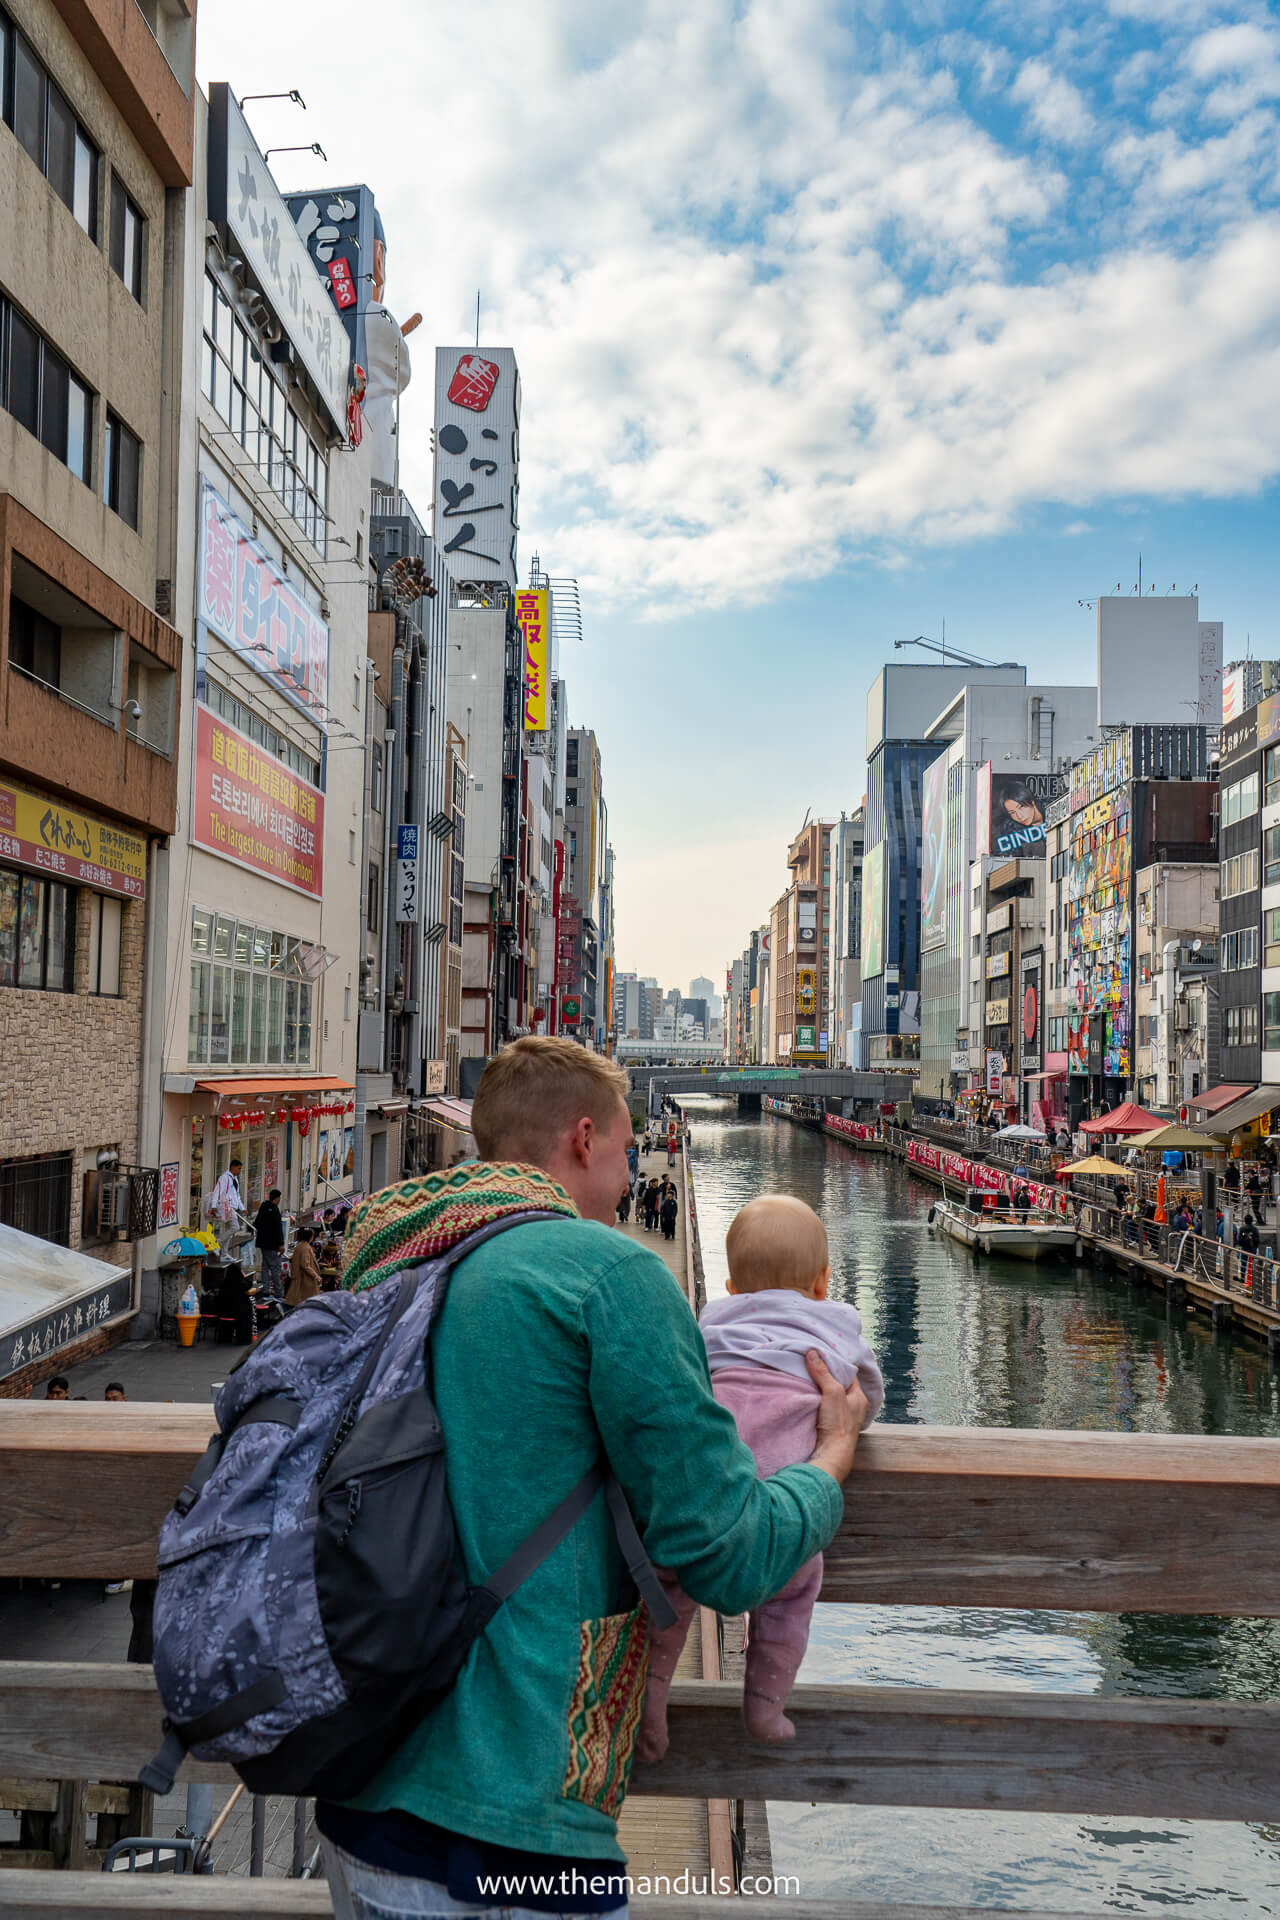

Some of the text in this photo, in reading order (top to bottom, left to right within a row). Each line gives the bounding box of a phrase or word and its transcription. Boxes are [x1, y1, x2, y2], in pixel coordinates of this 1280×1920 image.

[242, 558, 308, 688] ダイコク
[210, 773, 268, 833] 도톤보리에서
[35, 847, 67, 871] たこ焼き
[79, 863, 113, 885] お好み焼き
[210, 812, 226, 841] The
[227, 820, 255, 857] largest
[255, 841, 274, 864] store
[275, 847, 282, 868] in
[402, 828, 416, 857] 焼肉
[402, 861, 415, 919] いろりや
